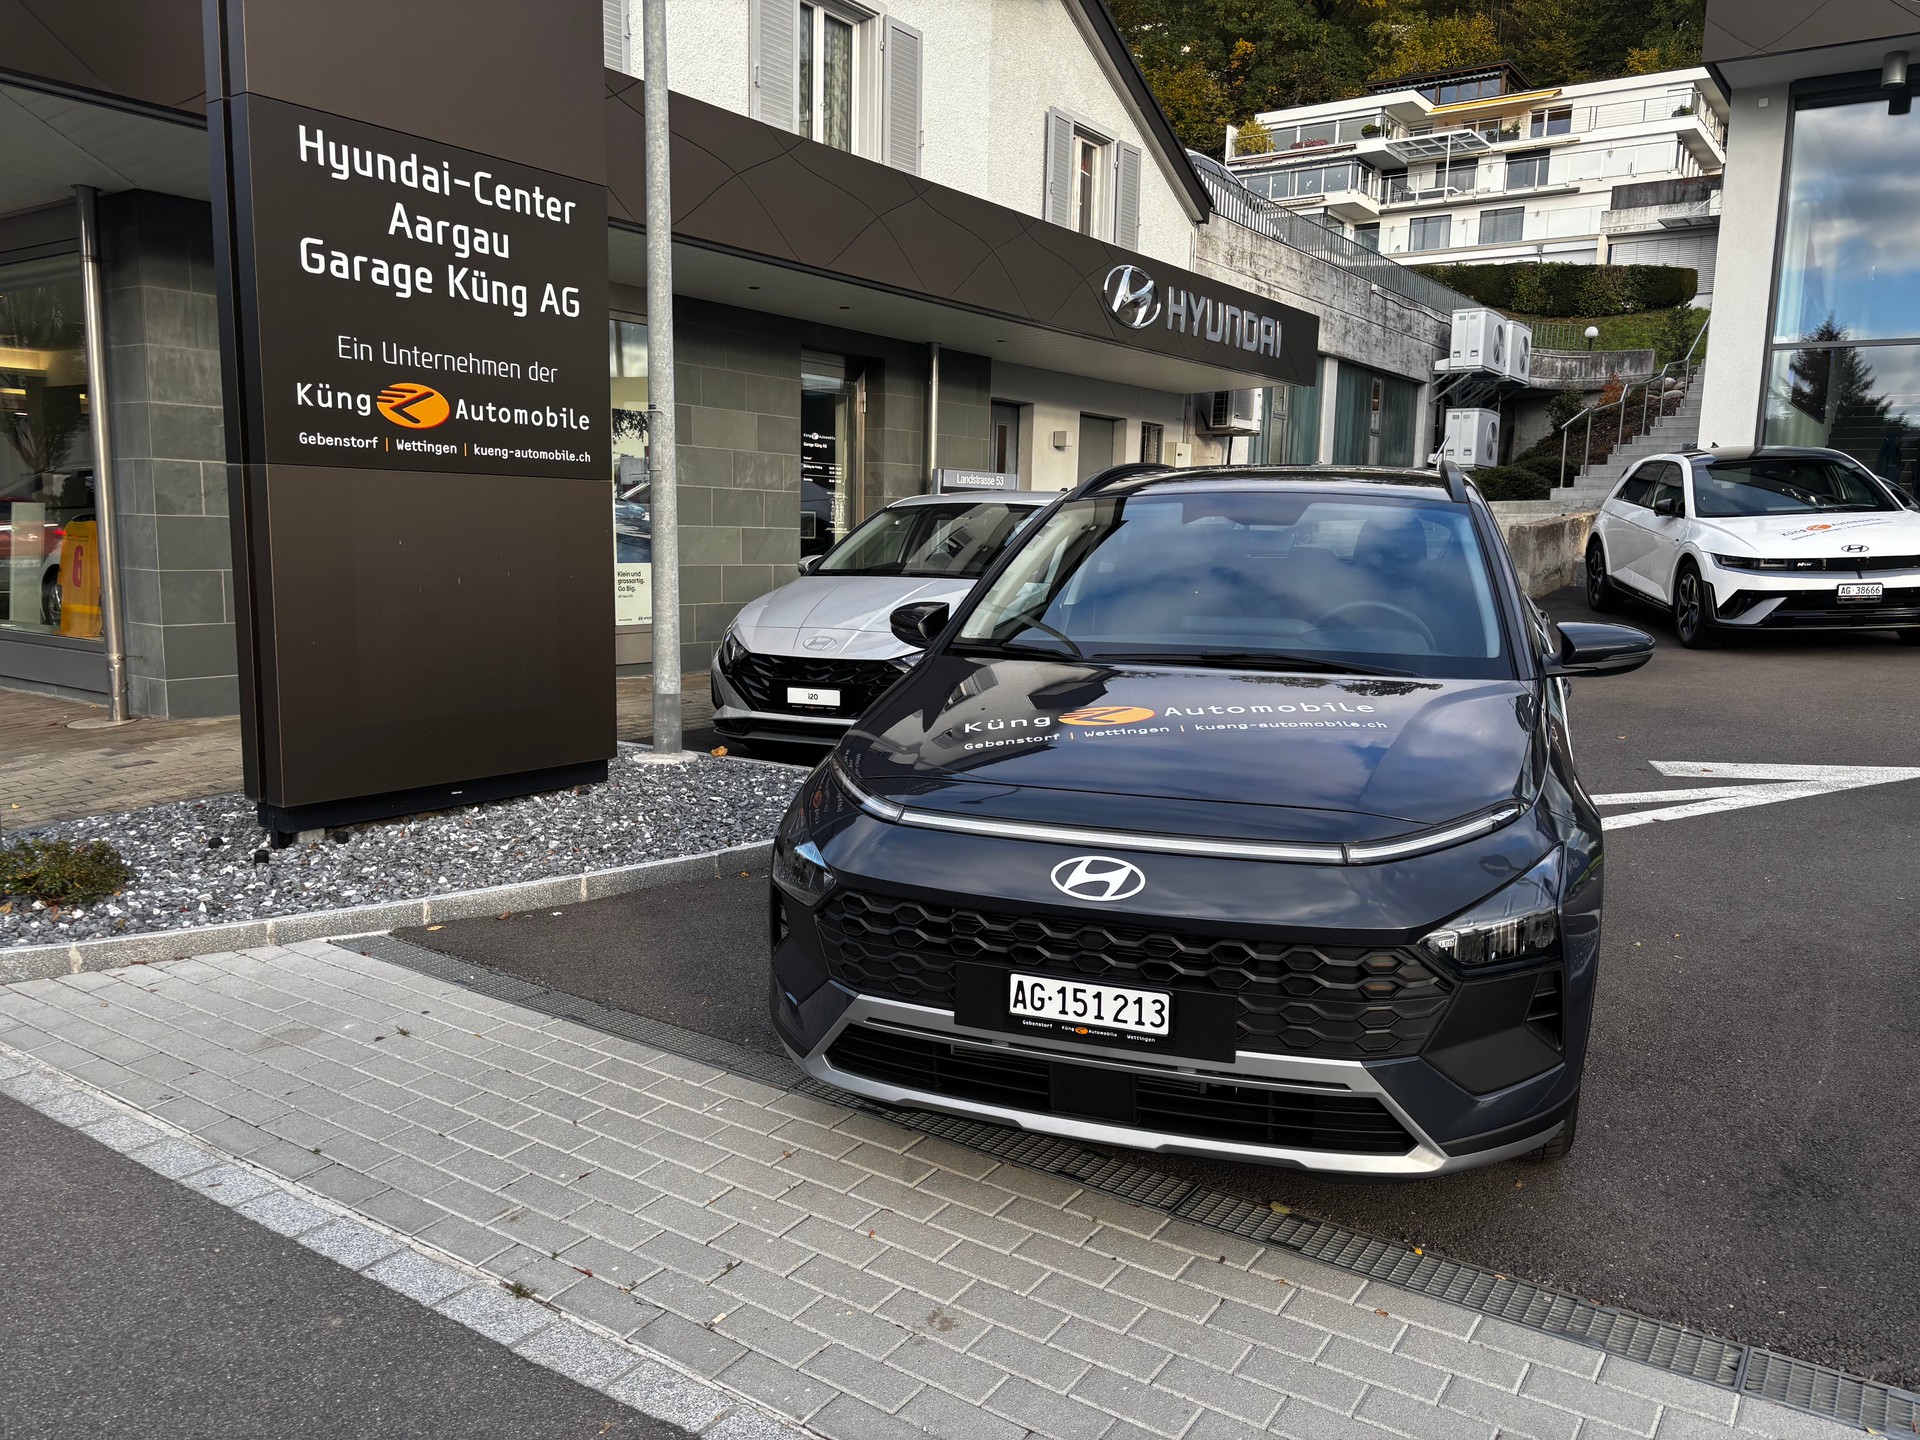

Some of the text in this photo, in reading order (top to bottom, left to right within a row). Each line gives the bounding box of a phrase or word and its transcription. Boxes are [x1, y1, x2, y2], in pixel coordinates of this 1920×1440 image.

[299, 125, 576, 225] Hyundai-Center
[388, 202, 510, 259] Aargau
[300, 237, 580, 318] Garage Küng AG
[1166, 286, 1282, 359] HYUNDAI
[338, 335, 558, 384] Ein Unternehmen der
[296, 382, 590, 431] Küng Automobile
[299, 432, 591, 463] Gebenstorf Wettingen kueng-automobile.ch
[956, 473, 1004, 486] Landstrasse 53
[807, 692, 819, 701] i20
[964, 702, 1376, 734] Küng Automobile
[964, 720, 1388, 751] Gebenstorf Wettingen kueng-automobile.ch
[1022, 1019, 1053, 1029] Gebenstorf
[1088, 1029, 1118, 1038] Automobile
